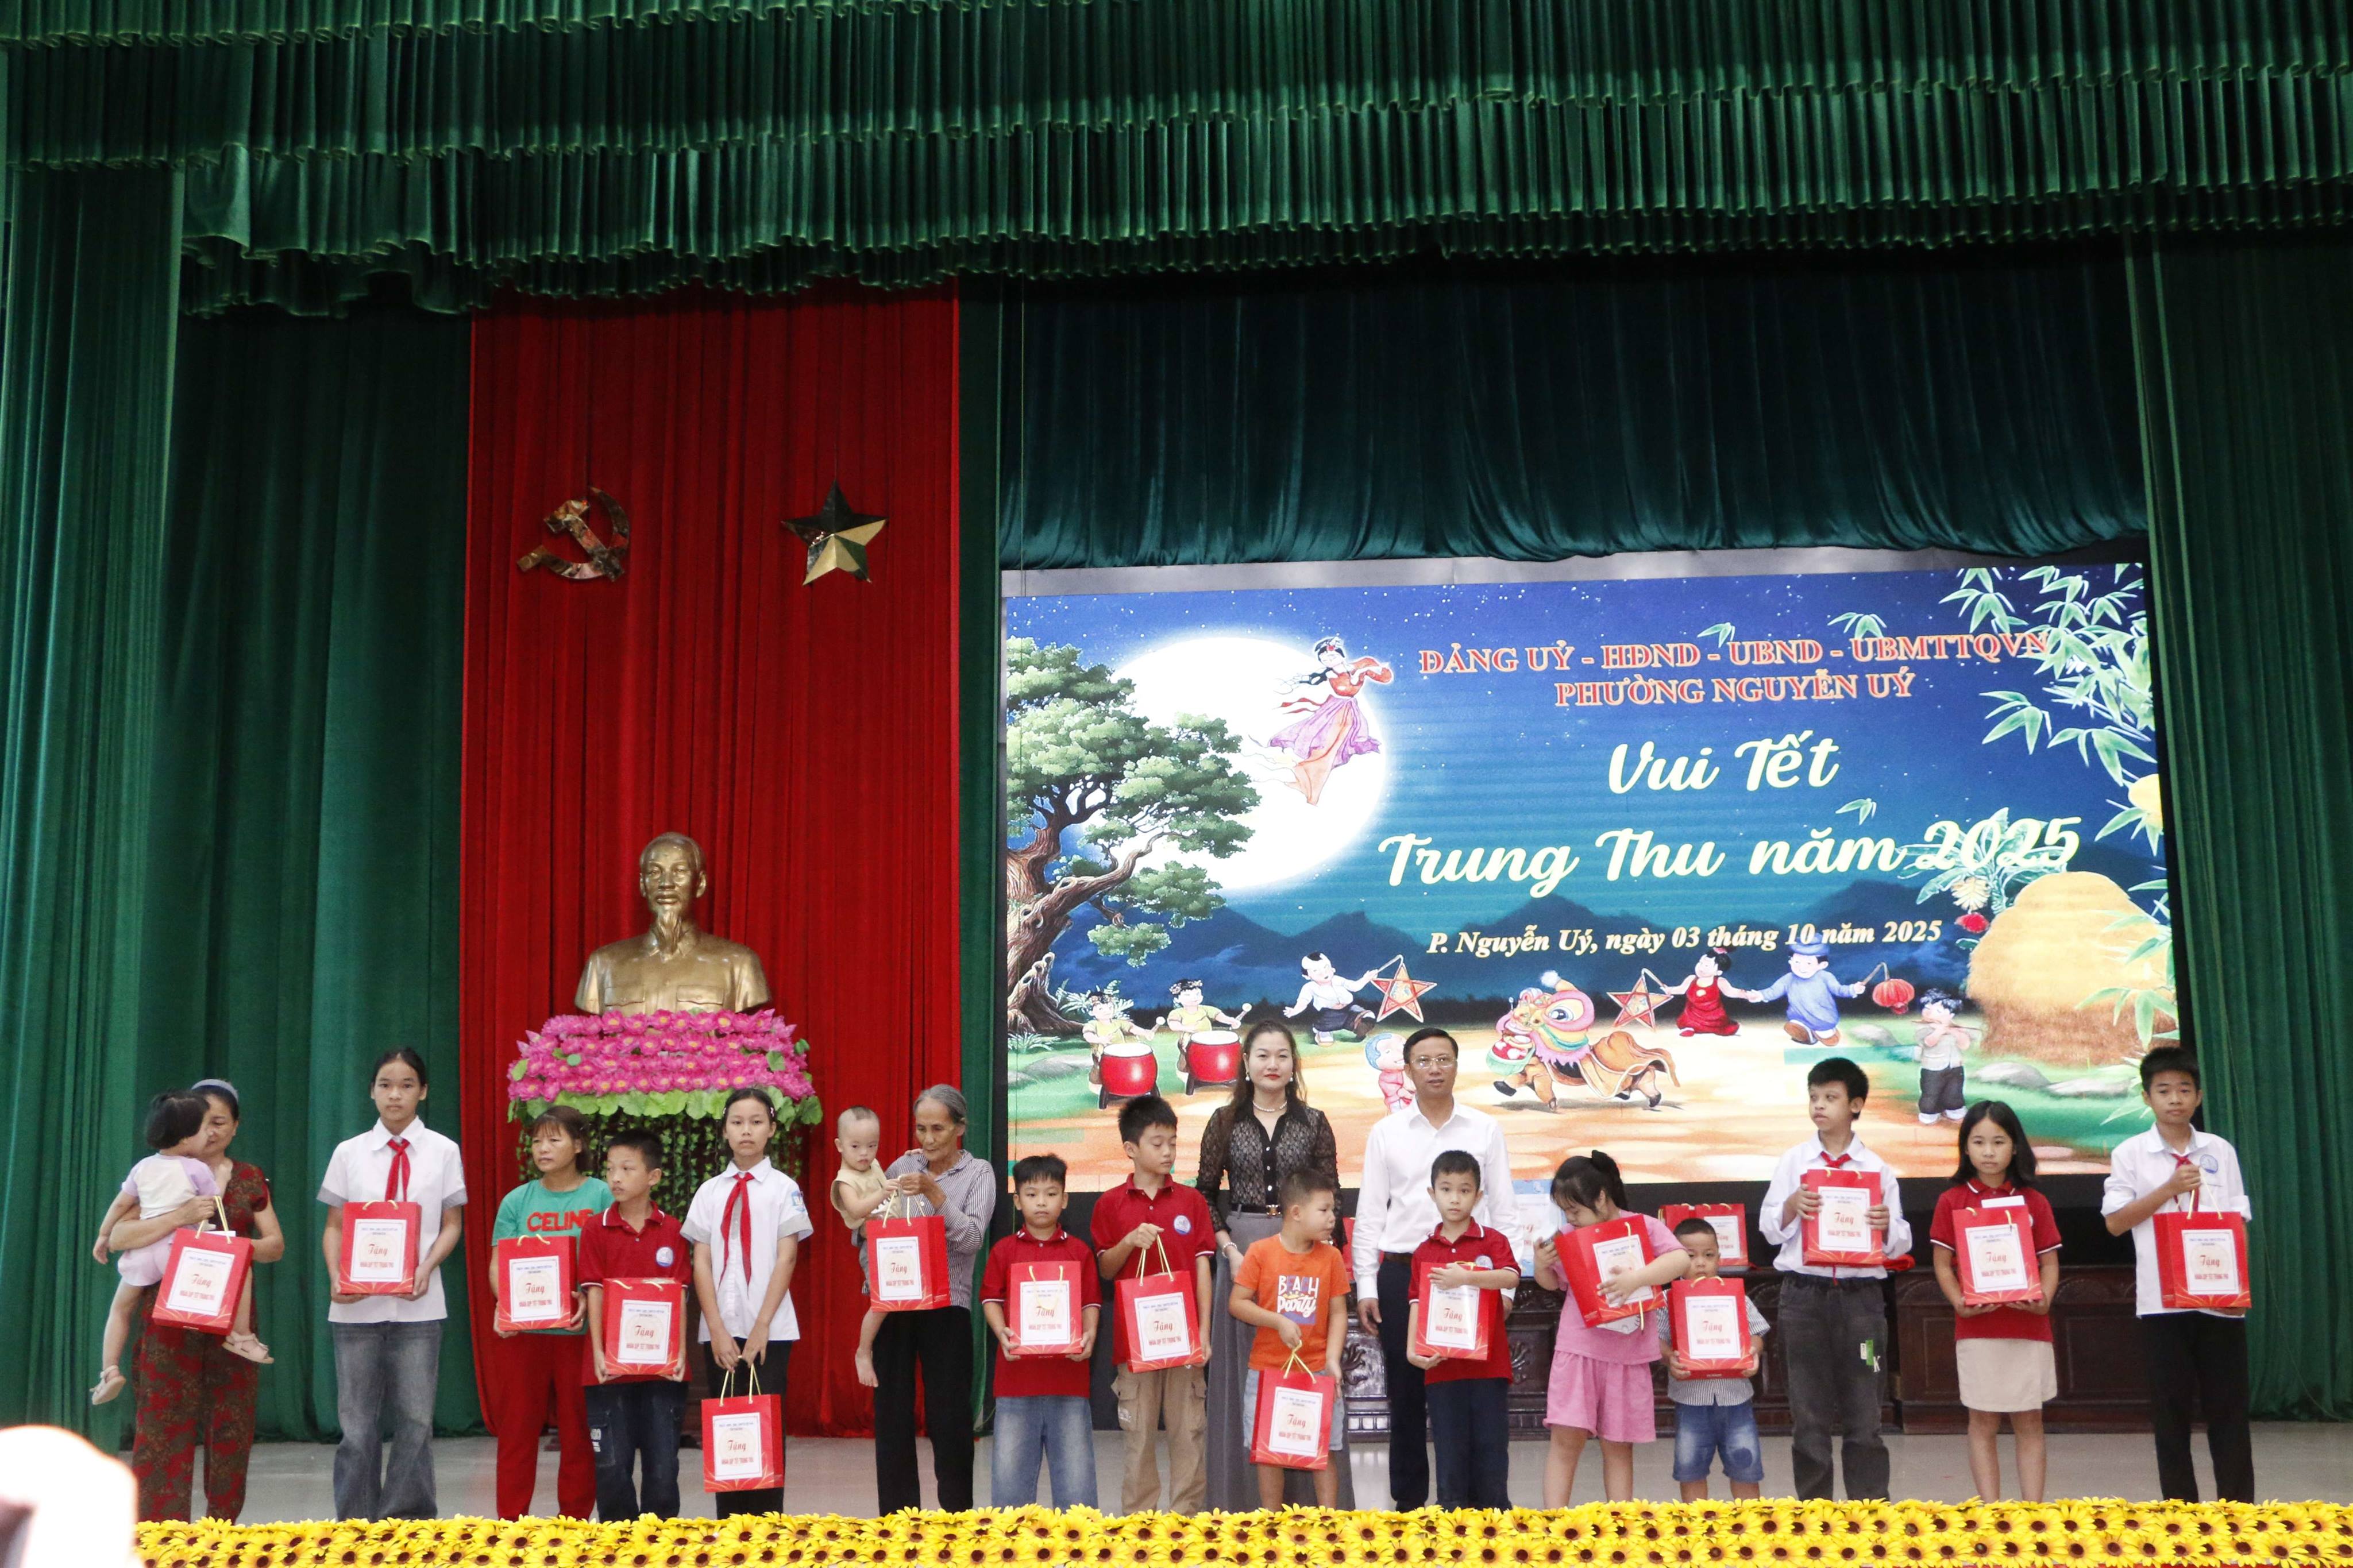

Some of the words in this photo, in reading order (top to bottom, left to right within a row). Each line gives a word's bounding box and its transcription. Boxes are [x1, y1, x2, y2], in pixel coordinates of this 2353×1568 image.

[1419, 642, 1519, 673] ĐẢNG
[1525, 640, 1575, 671] UỶ
[1600, 643, 1701, 669] HĐND
[1727, 639, 1823, 665] UBND
[1850, 632, 2050, 662] UBMTTQVN
[1554, 674, 1705, 706] PHƯỜNG
[1711, 669, 1858, 702] NGUYỄN
[1865, 666, 1915, 697] UÝ
[1608, 741, 1719, 794] Vui
[1734, 730, 1839, 791] Tết
[1378, 833, 1580, 898] Trung
[1595, 828, 1725, 880] Thu
[1748, 827, 1908, 875] năm
[1914, 817, 2081, 870] 2025
[1426, 932, 1448, 953] P.
[1455, 925, 1549, 958] Nguyễn
[1559, 929, 1598, 956] Uý,
[1606, 928, 1665, 955] ngày
[1672, 926, 1701, 948] 03
[1707, 925, 1779, 951] tháng
[1784, 924, 1816, 945] 10
[1822, 922, 1874, 944] năm
[1881, 920, 1942, 943] 2025
